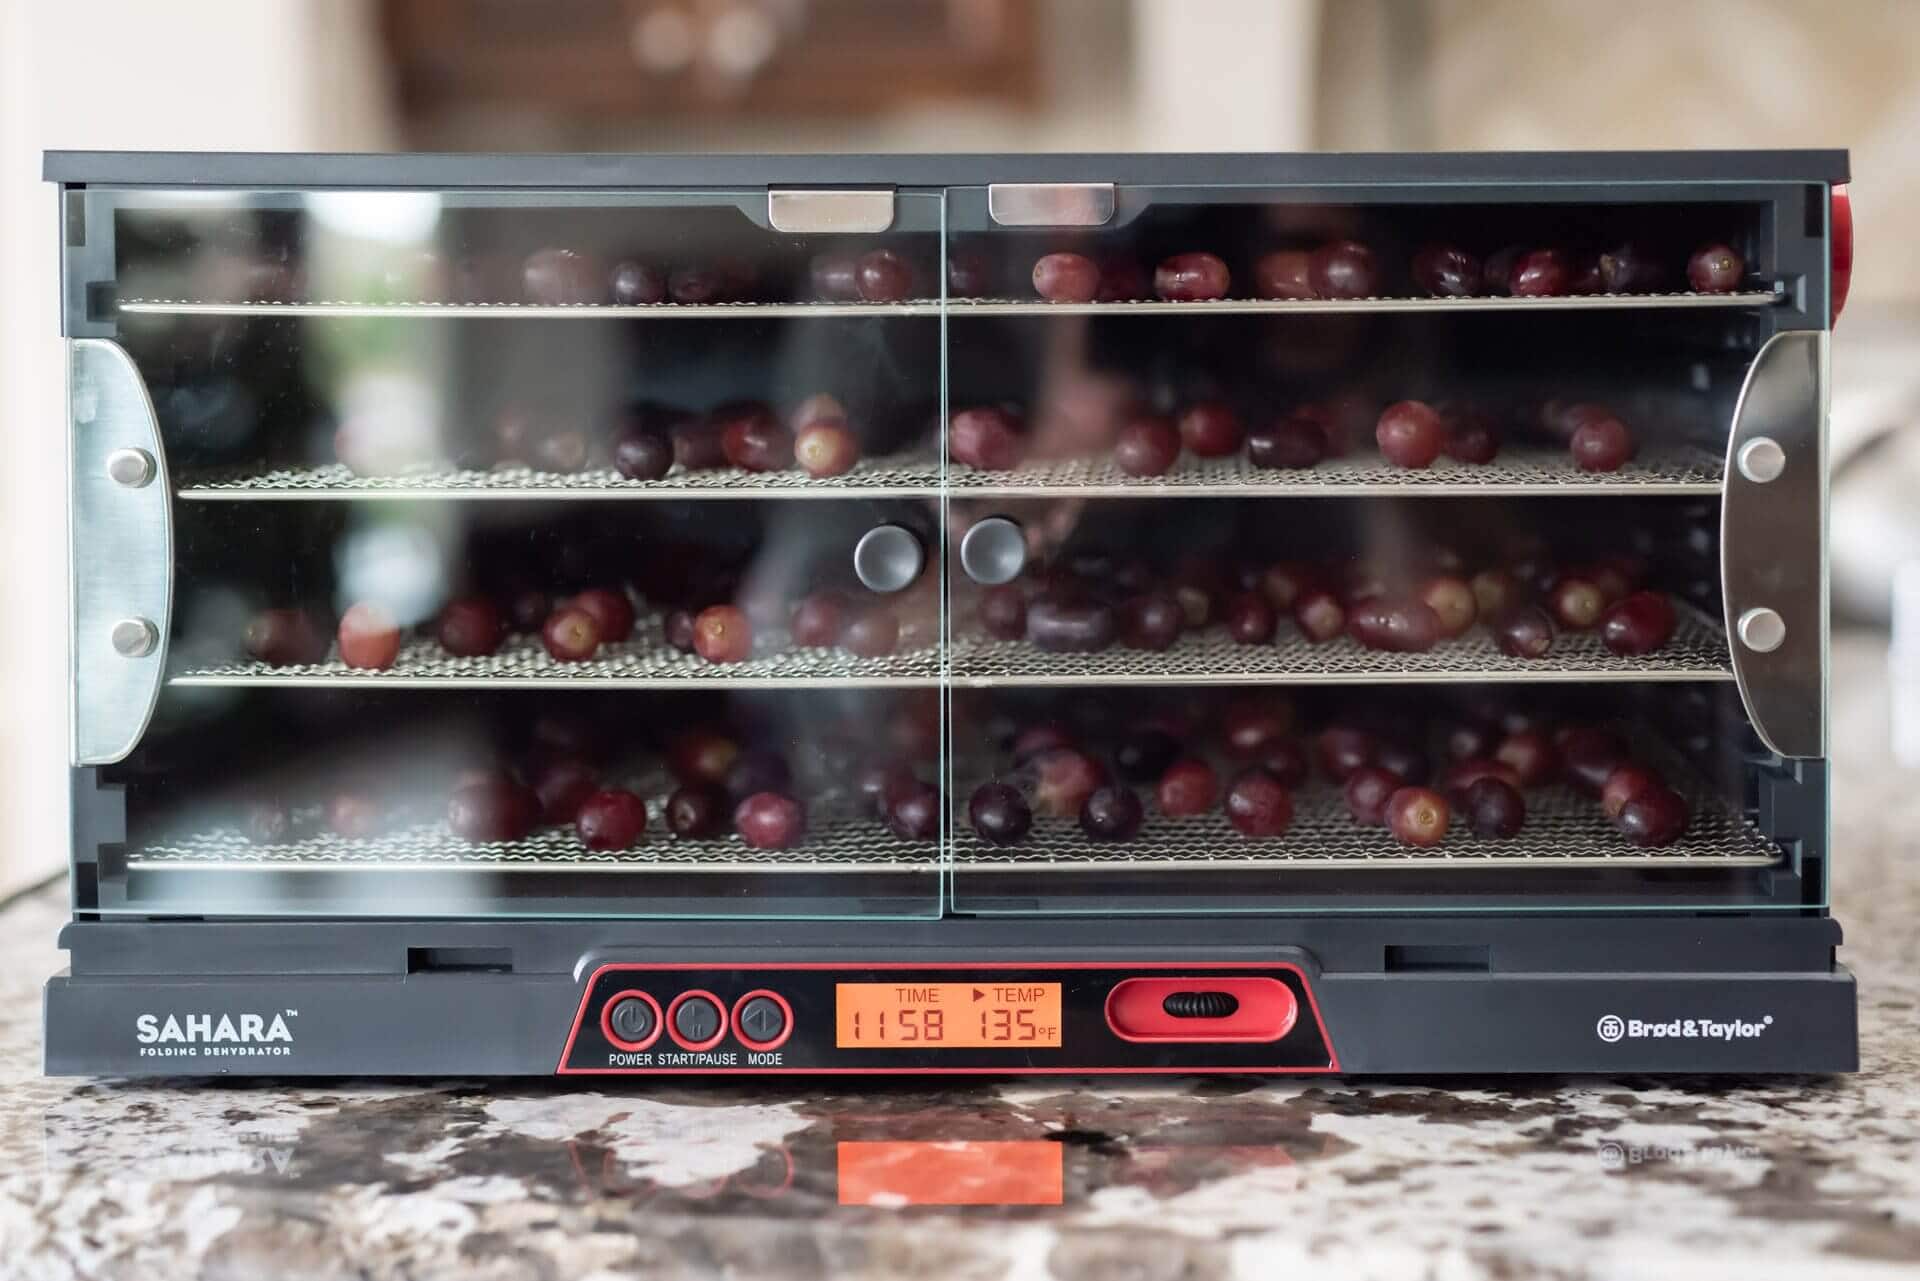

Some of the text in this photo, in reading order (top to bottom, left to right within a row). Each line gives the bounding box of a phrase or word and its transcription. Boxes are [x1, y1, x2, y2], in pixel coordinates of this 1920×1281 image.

[896, 988, 941, 1003] TIME
[992, 987, 1046, 1002] TEMP
[140, 1047, 291, 1057] FOLDING DEHYDRATOR
[658, 1052, 737, 1066] START/PAUSE
[747, 1052, 783, 1066] MODE
[609, 1053, 653, 1066] POWER
